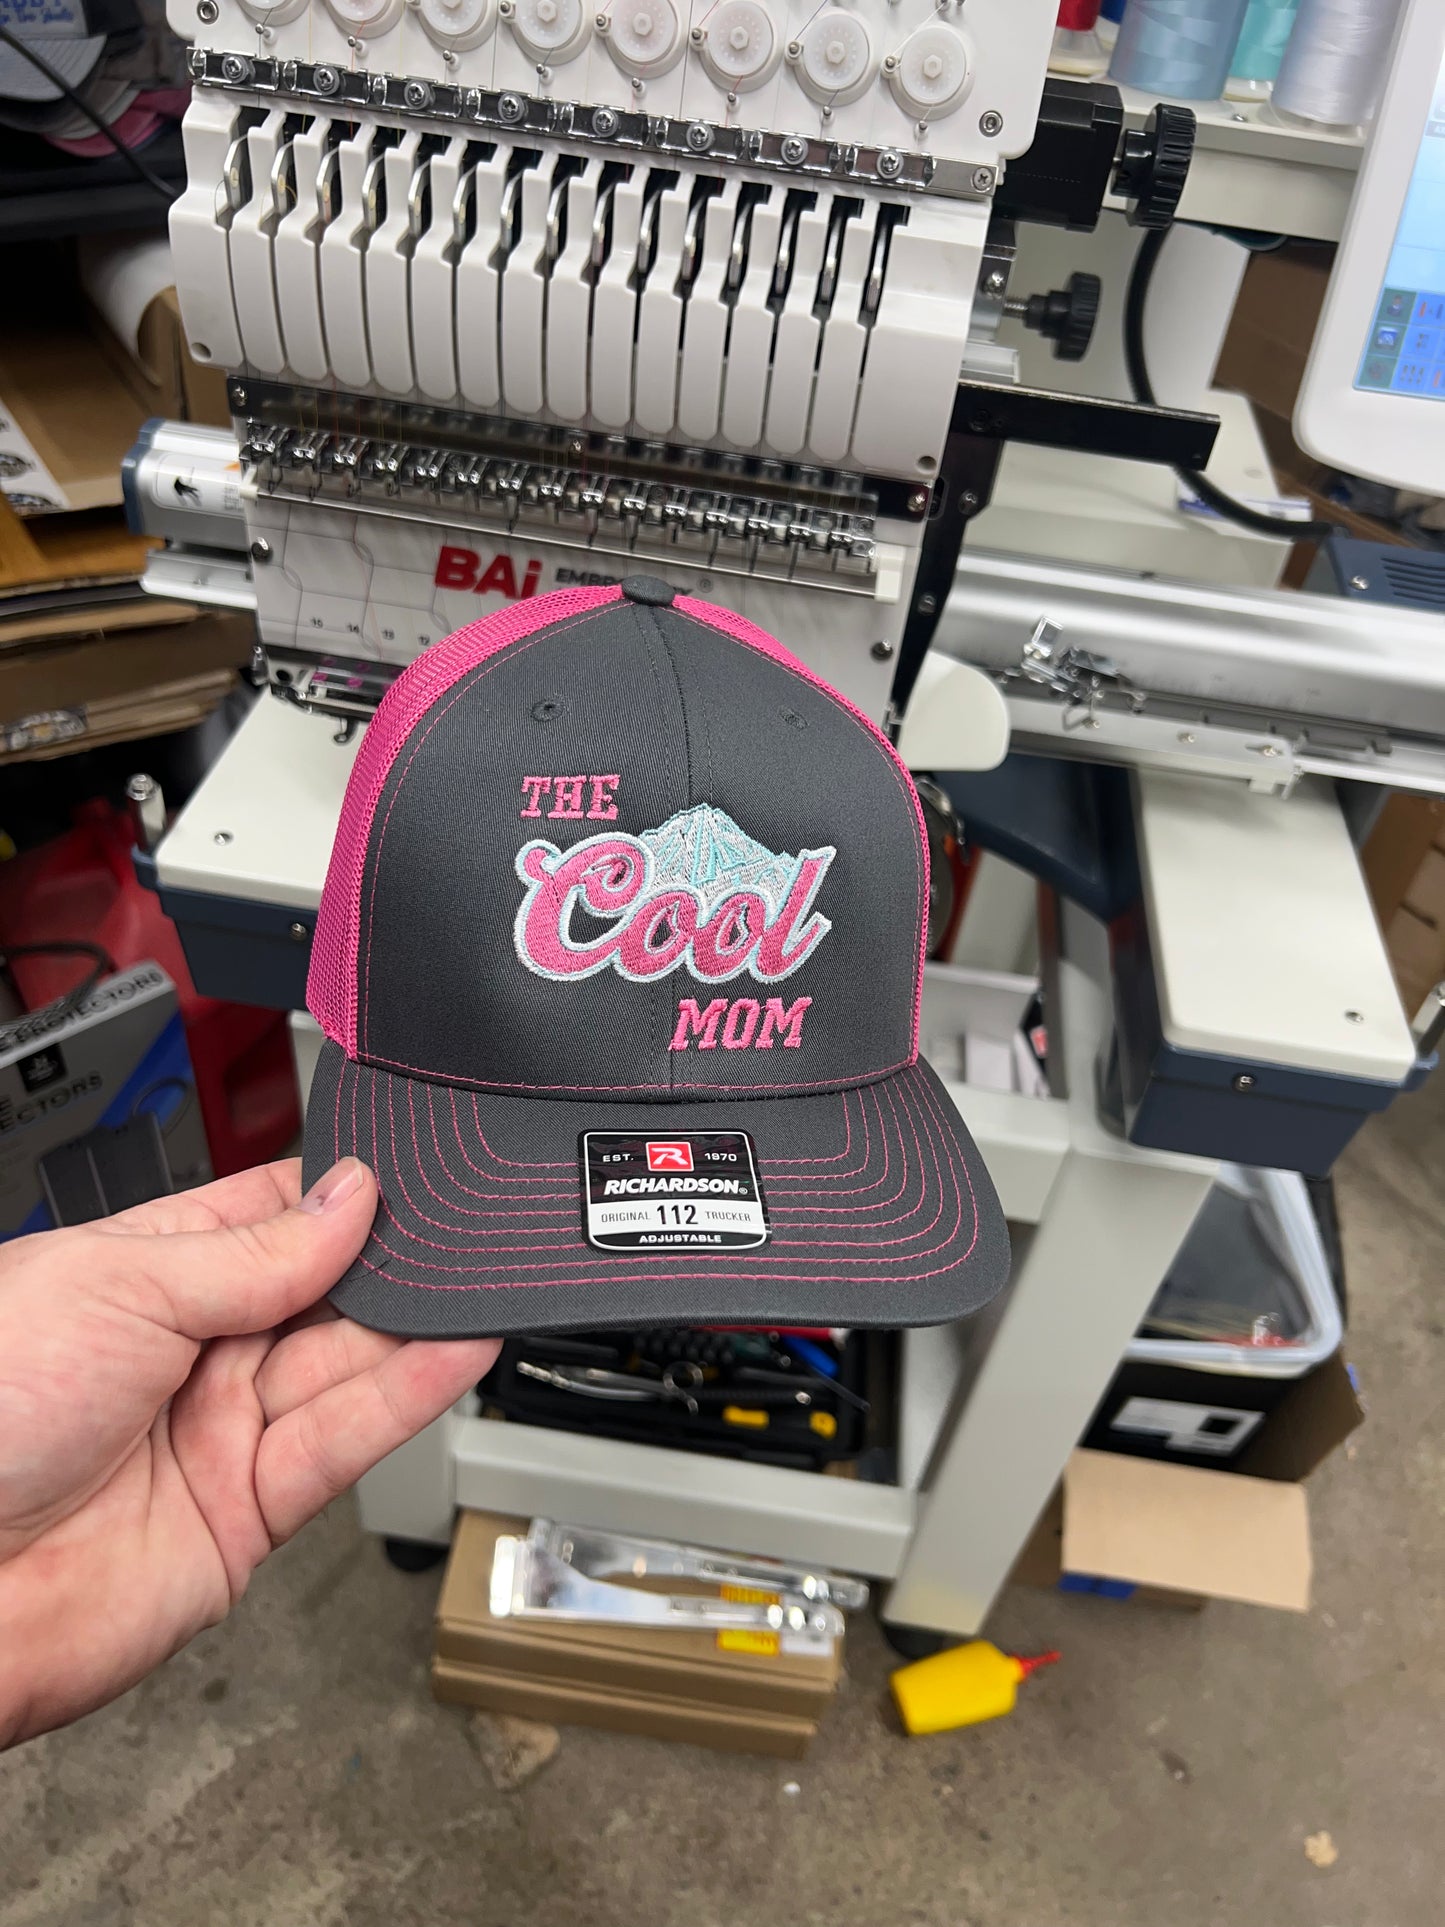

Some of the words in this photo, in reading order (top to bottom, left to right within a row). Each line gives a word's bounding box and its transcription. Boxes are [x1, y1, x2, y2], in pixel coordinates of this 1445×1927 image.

[434, 545, 543, 600] BAi
[520, 774, 621, 820] THE
[514, 831, 837, 984] Cool
[668, 996, 812, 1051] MOM
[602, 1153, 634, 1163] EST.
[704, 1152, 738, 1162] 1970
[601, 1211, 651, 1223] ORIGINAL
[656, 1204, 698, 1225] 112
[704, 1210, 751, 1222] TRUCKER
[638, 1233, 722, 1244] ADJUSTABLE
